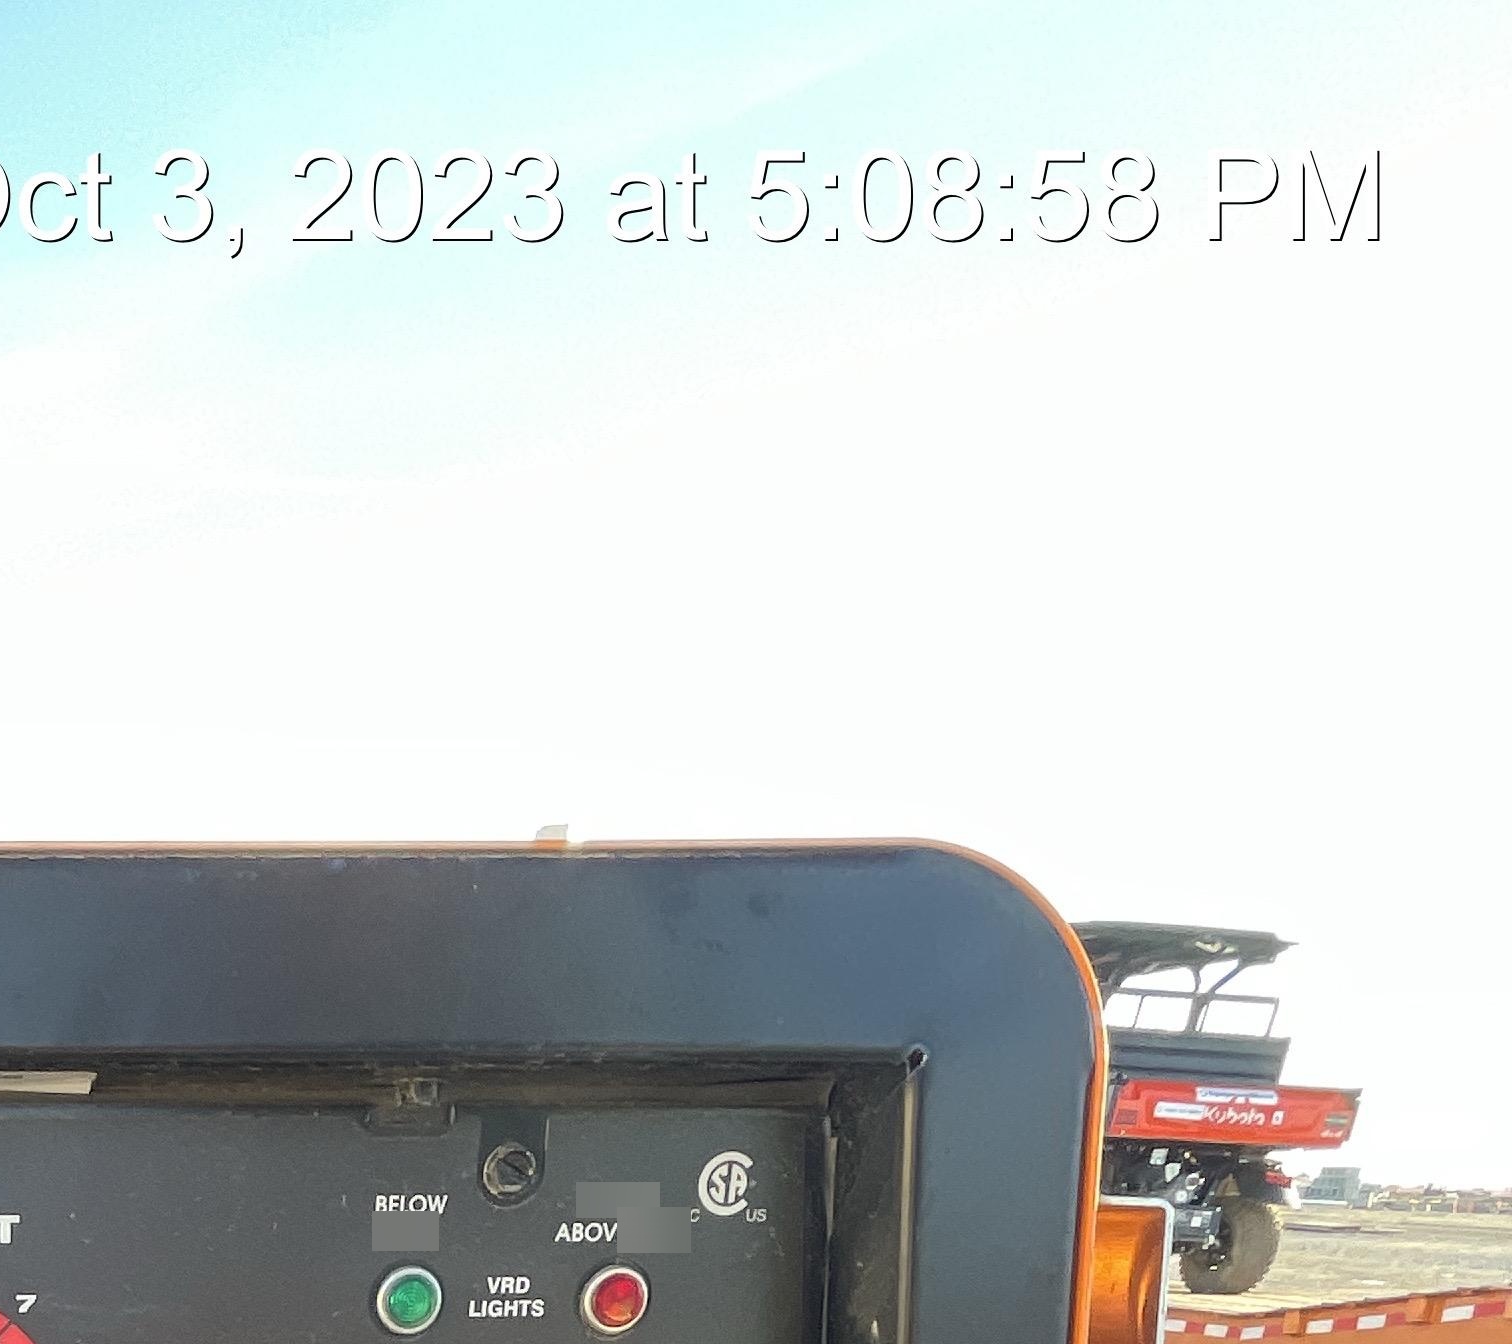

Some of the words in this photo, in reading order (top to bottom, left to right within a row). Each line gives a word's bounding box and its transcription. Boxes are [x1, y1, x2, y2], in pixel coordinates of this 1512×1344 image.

[554, 1222, 618, 1243] ABOV
[487, 1277, 531, 1294] VRD
[15, 1294, 38, 1314] 7
[468, 1299, 545, 1318] LIGHTS
